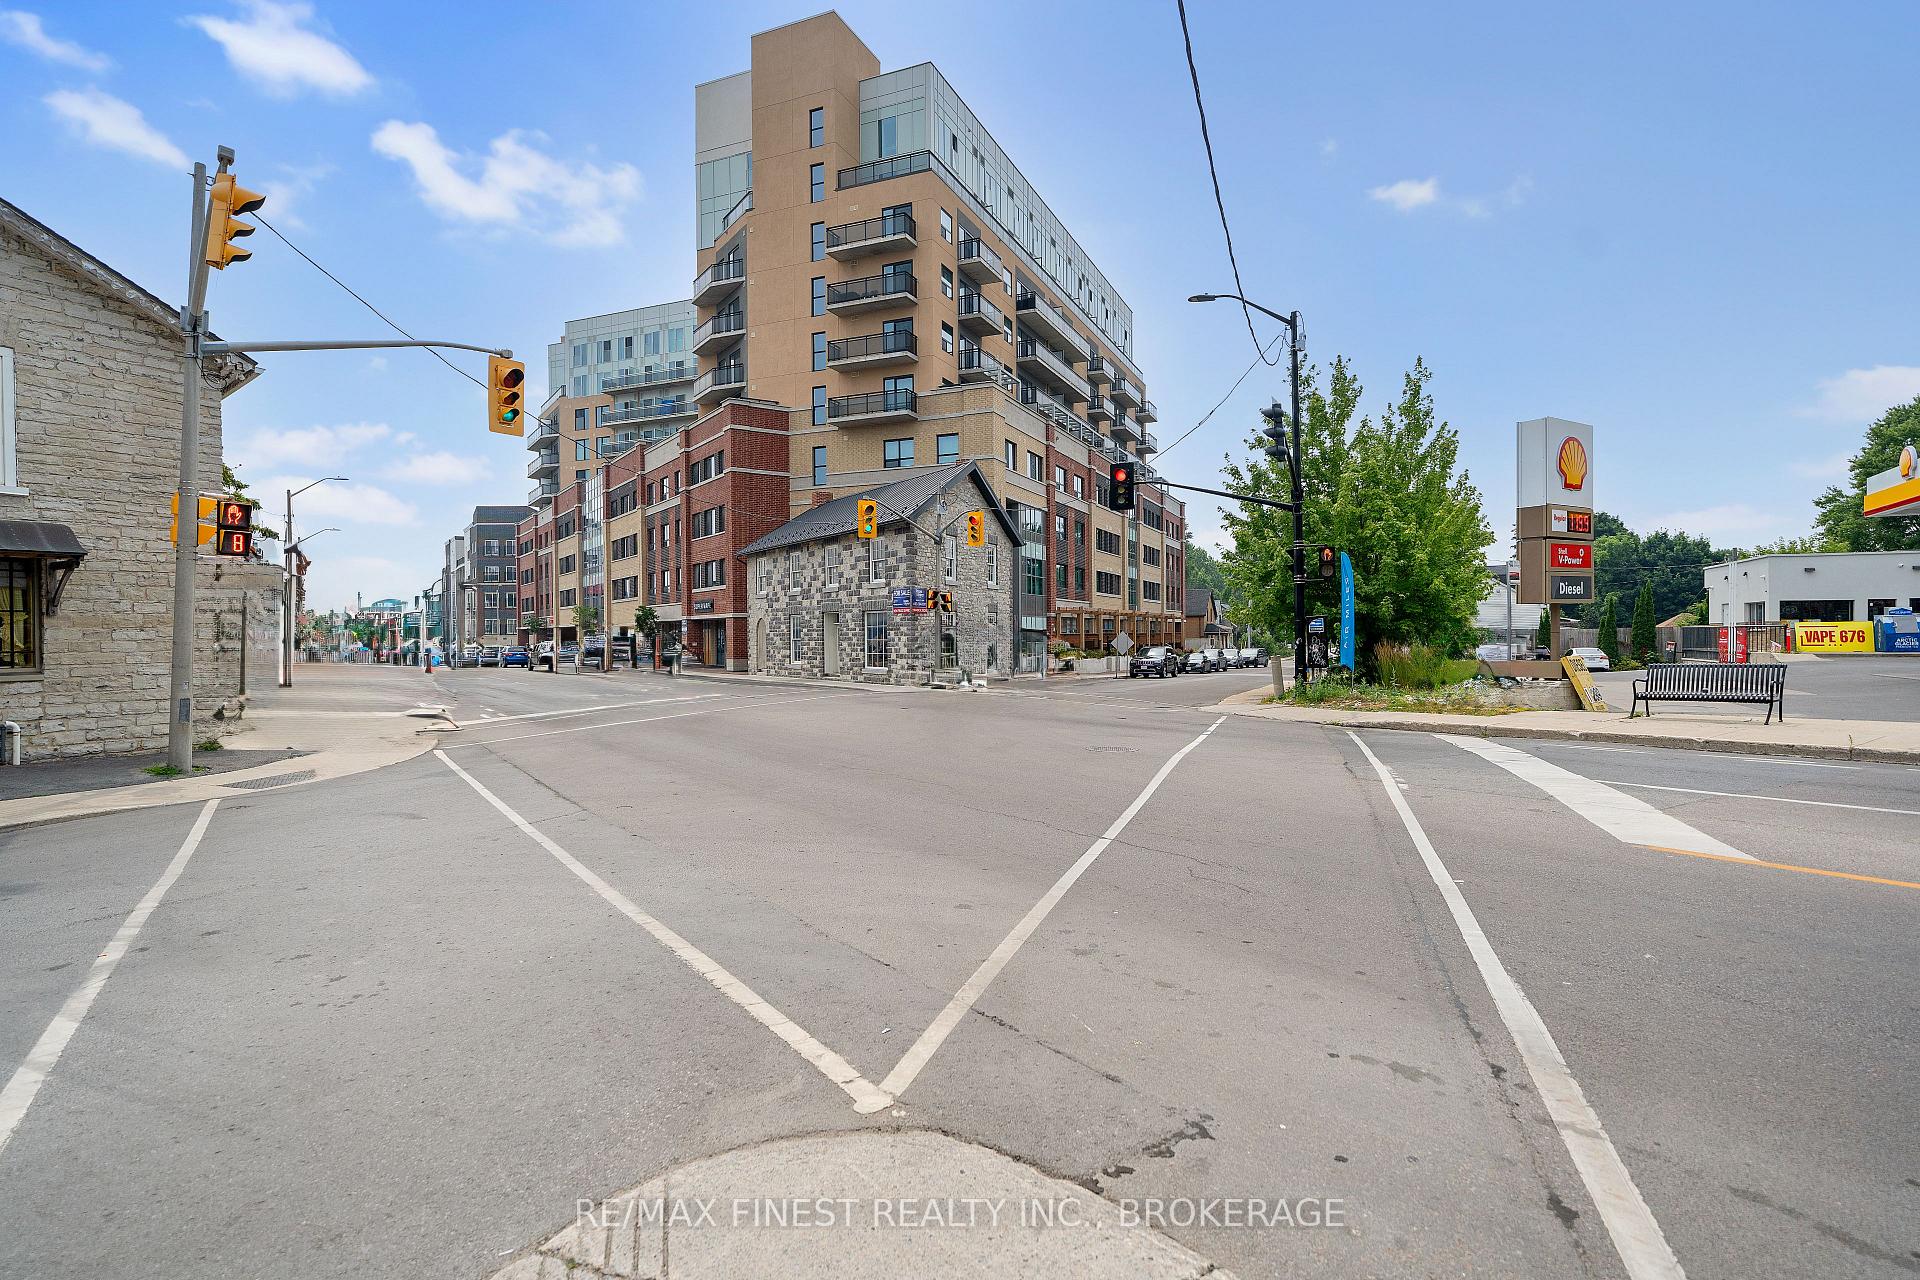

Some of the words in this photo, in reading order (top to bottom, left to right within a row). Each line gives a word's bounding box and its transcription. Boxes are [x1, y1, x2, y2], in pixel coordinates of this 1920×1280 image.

[1558, 547, 1568, 555] Shell
[1558, 555, 1583, 565] V-Power
[1559, 581, 1584, 595] Diesel
[1804, 630, 1836, 643] VAPE
[1839, 629, 1866, 643] 676
